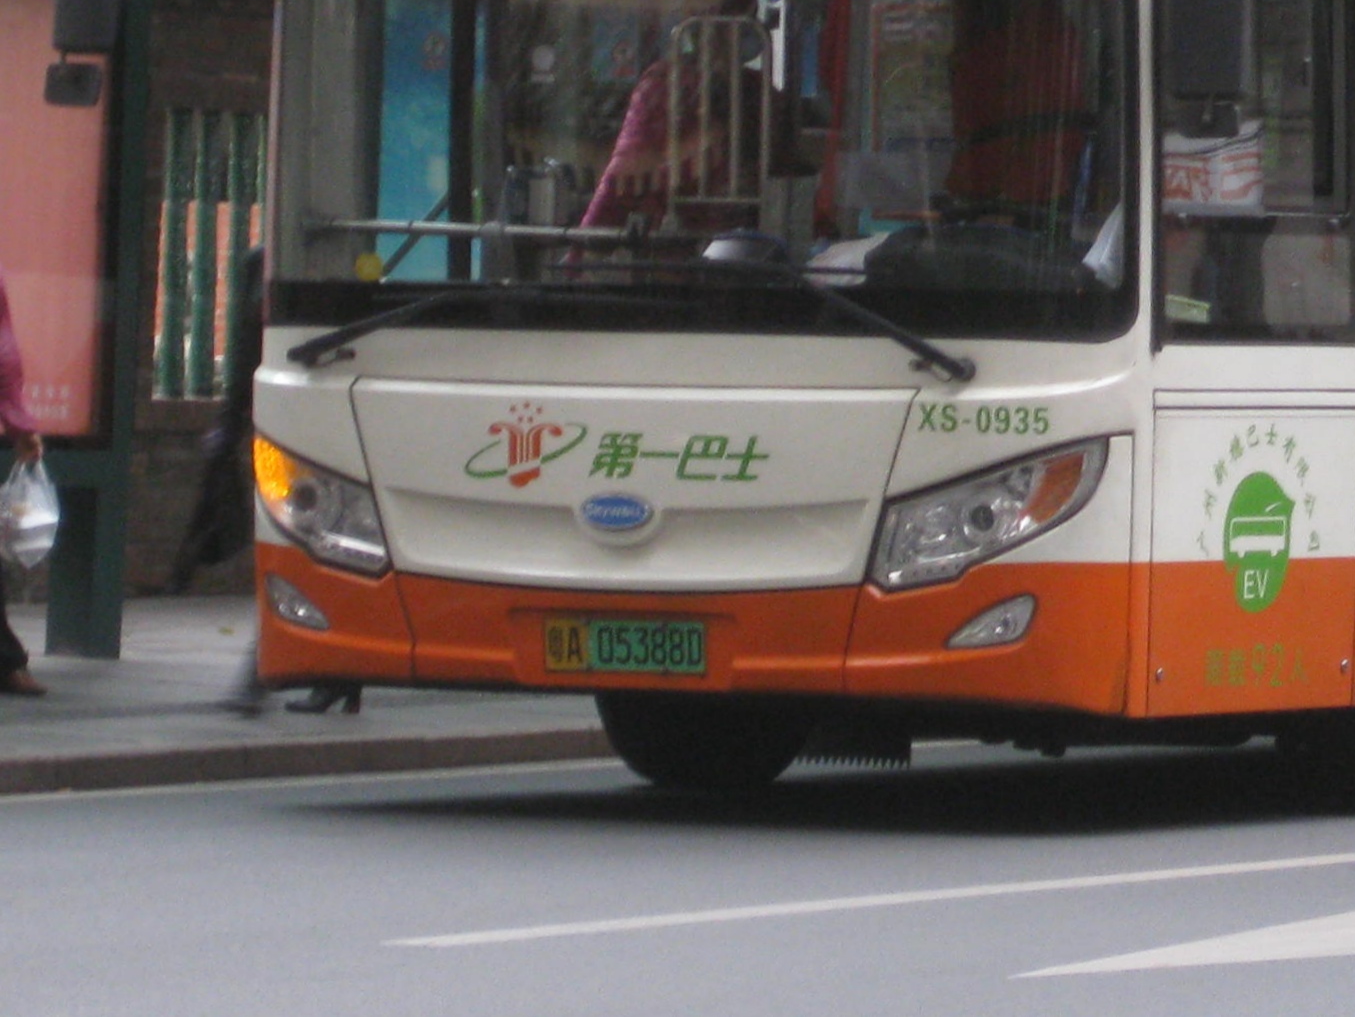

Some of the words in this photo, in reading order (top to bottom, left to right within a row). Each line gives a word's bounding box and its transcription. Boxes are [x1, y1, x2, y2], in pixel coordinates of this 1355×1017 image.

[918, 403, 1049, 434] XS-0935
[589, 433, 770, 481] 第一巴士
[1243, 570, 1269, 600] EV
